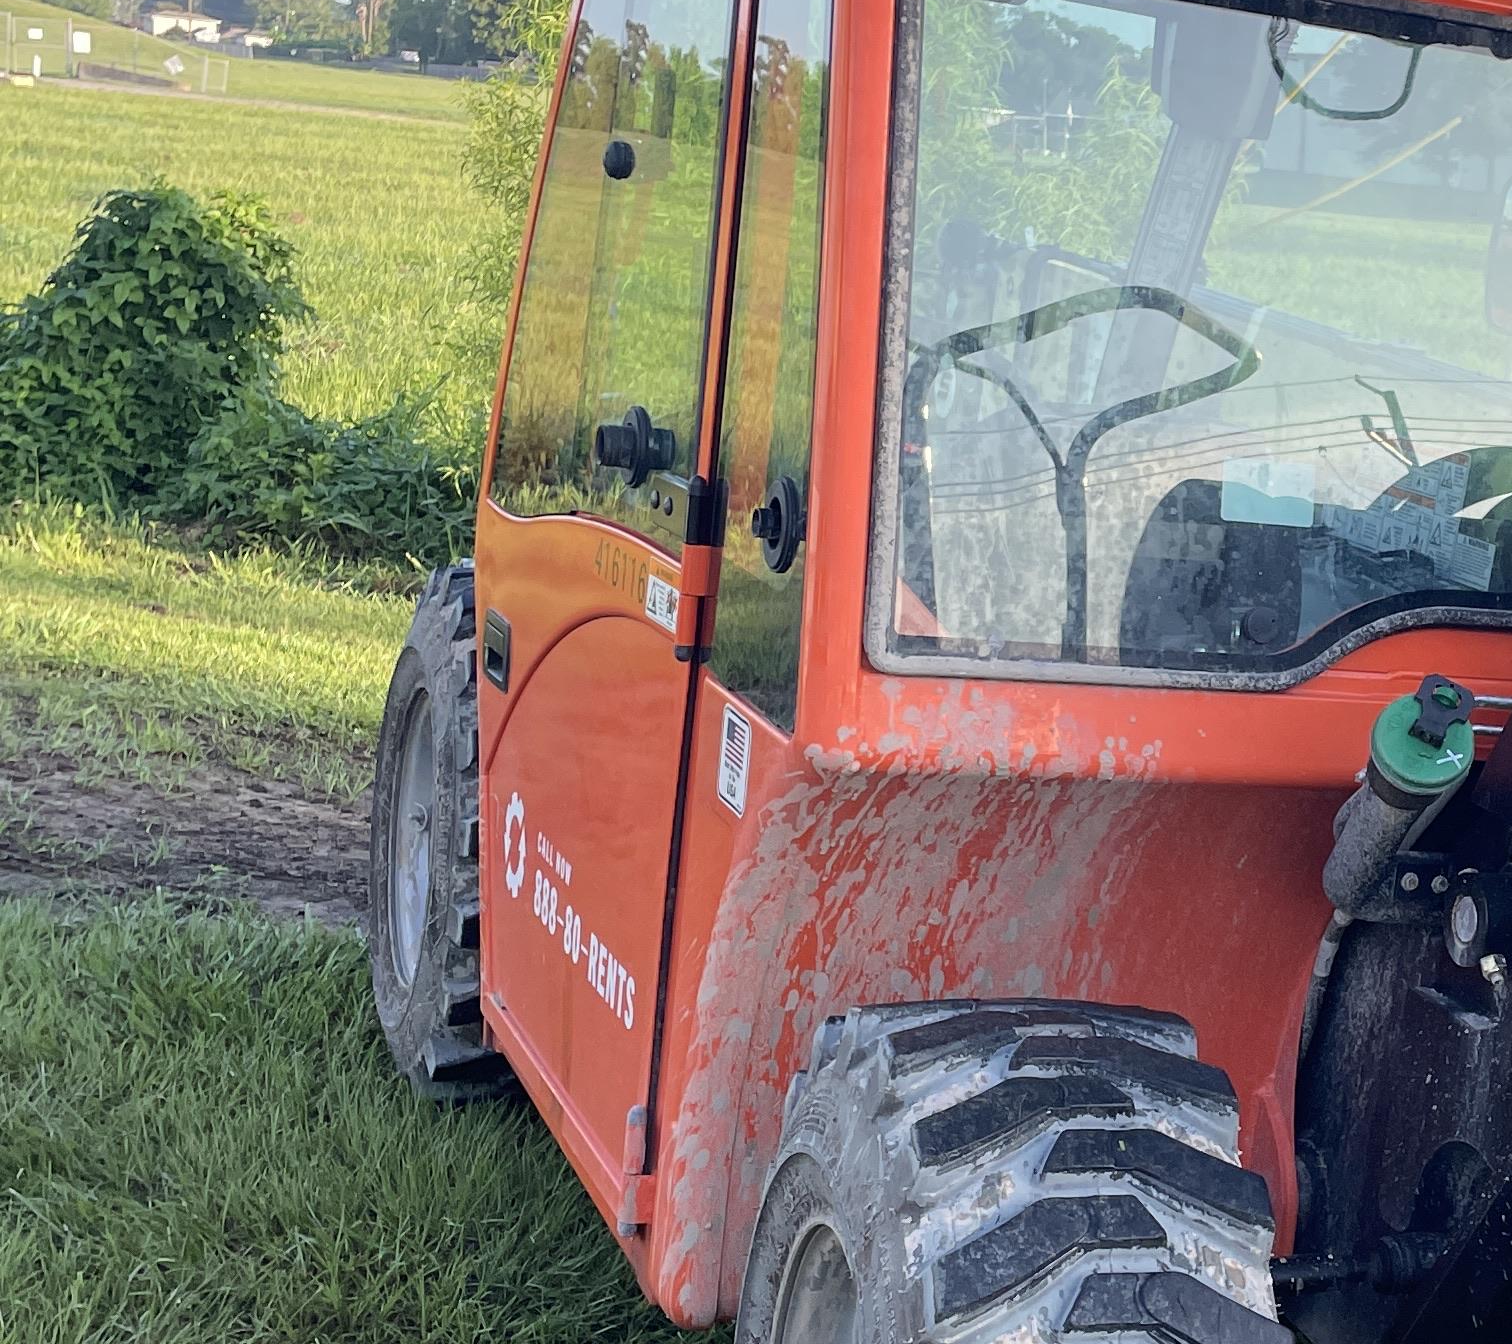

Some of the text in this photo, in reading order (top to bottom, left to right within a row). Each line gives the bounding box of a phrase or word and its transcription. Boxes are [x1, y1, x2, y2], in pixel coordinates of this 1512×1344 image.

[537, 831, 573, 887] CALL NOW
[533, 869, 636, 1030] 888-80-RENTS
